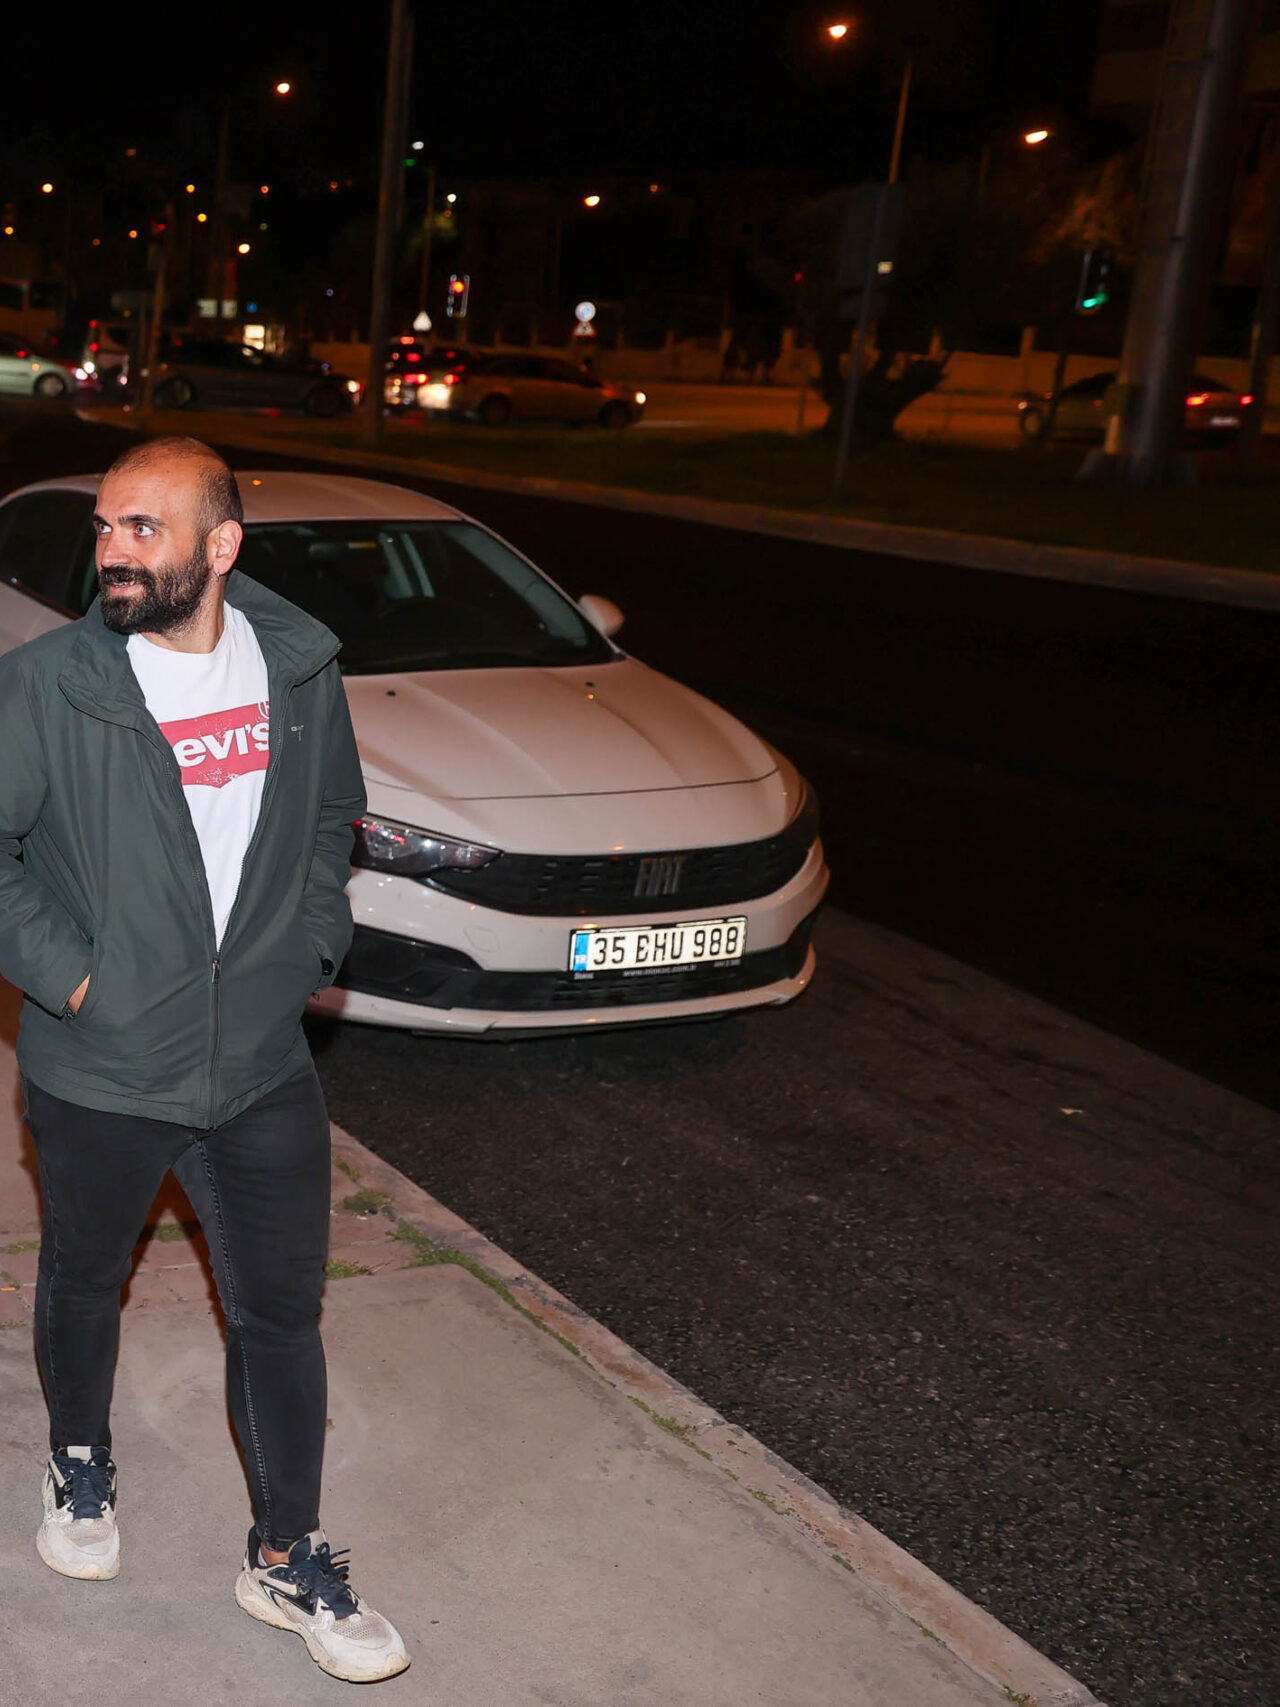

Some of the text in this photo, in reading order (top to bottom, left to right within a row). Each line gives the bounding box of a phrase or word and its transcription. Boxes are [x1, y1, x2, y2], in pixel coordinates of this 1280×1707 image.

[173, 721, 270, 768] evi's
[593, 925, 739, 965] 35 BHU 988
